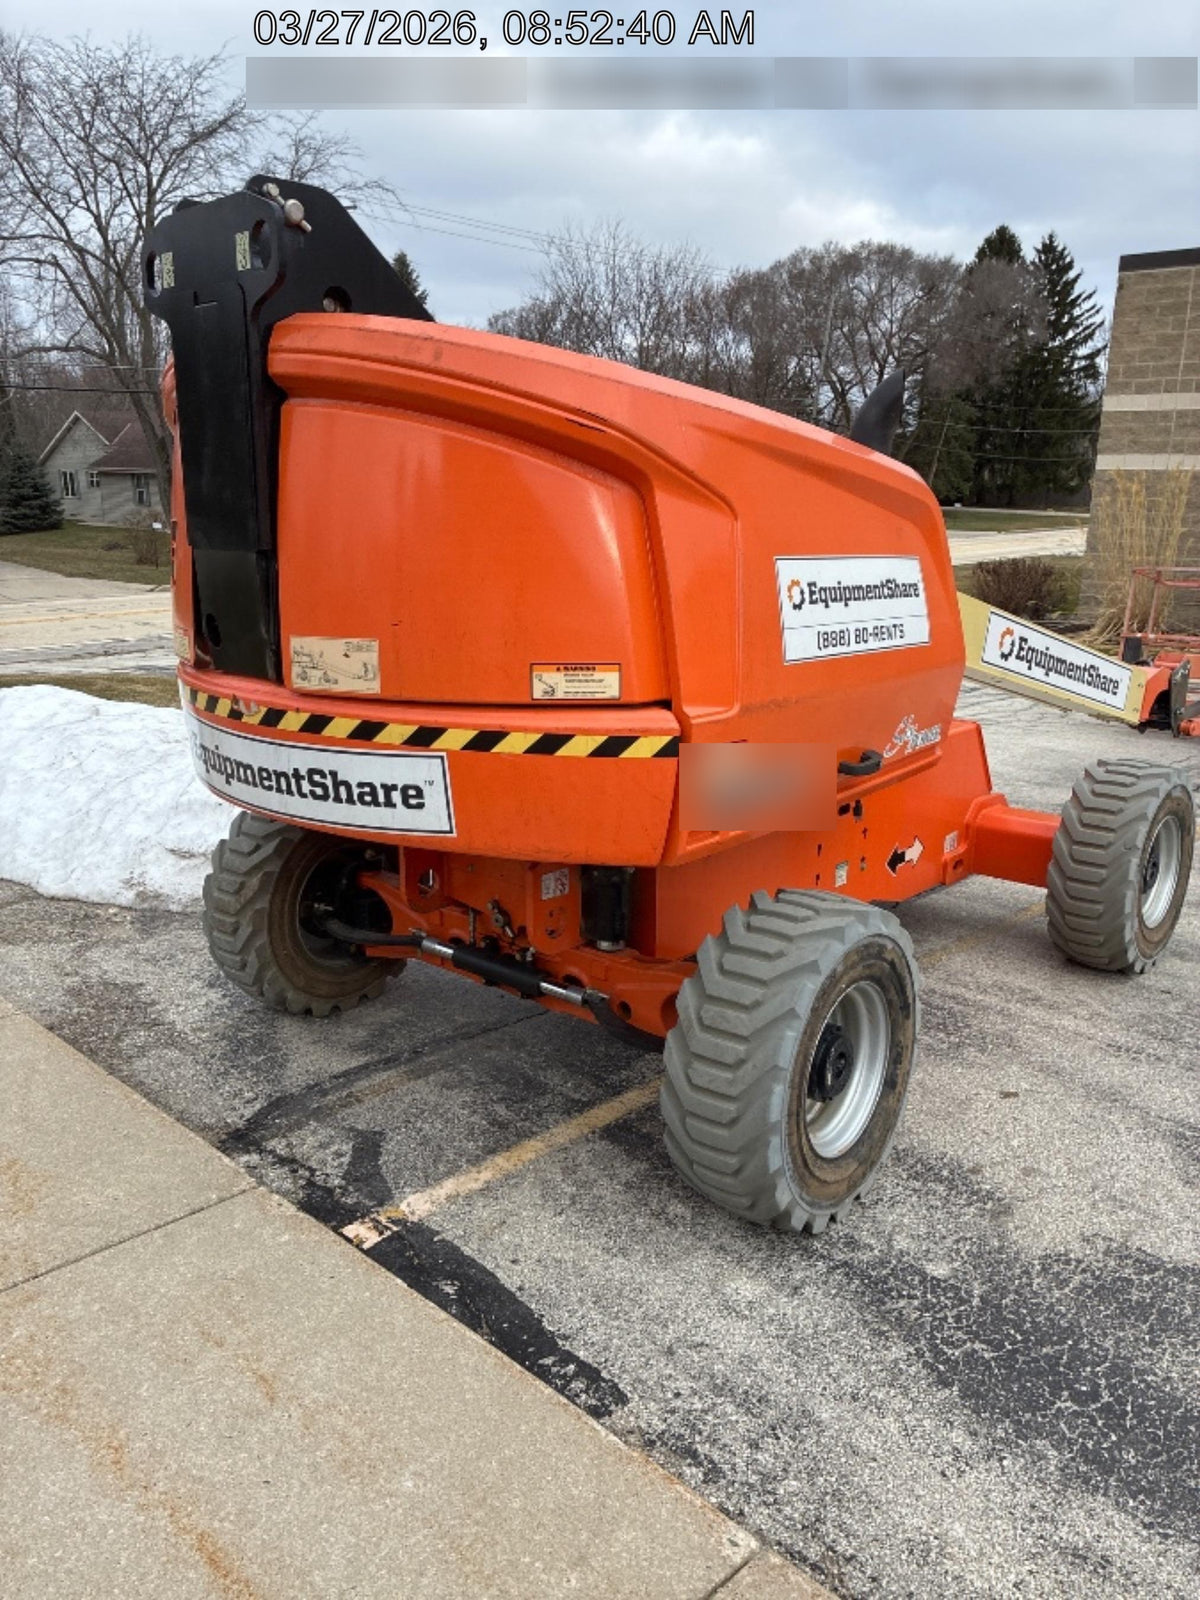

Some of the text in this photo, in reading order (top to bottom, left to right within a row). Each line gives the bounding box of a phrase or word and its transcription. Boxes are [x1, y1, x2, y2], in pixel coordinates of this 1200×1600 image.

[807, 578, 920, 608] EquipmentShare
[817, 629, 851, 650] (888)
[1015, 636, 1120, 695] EquipmentShare
